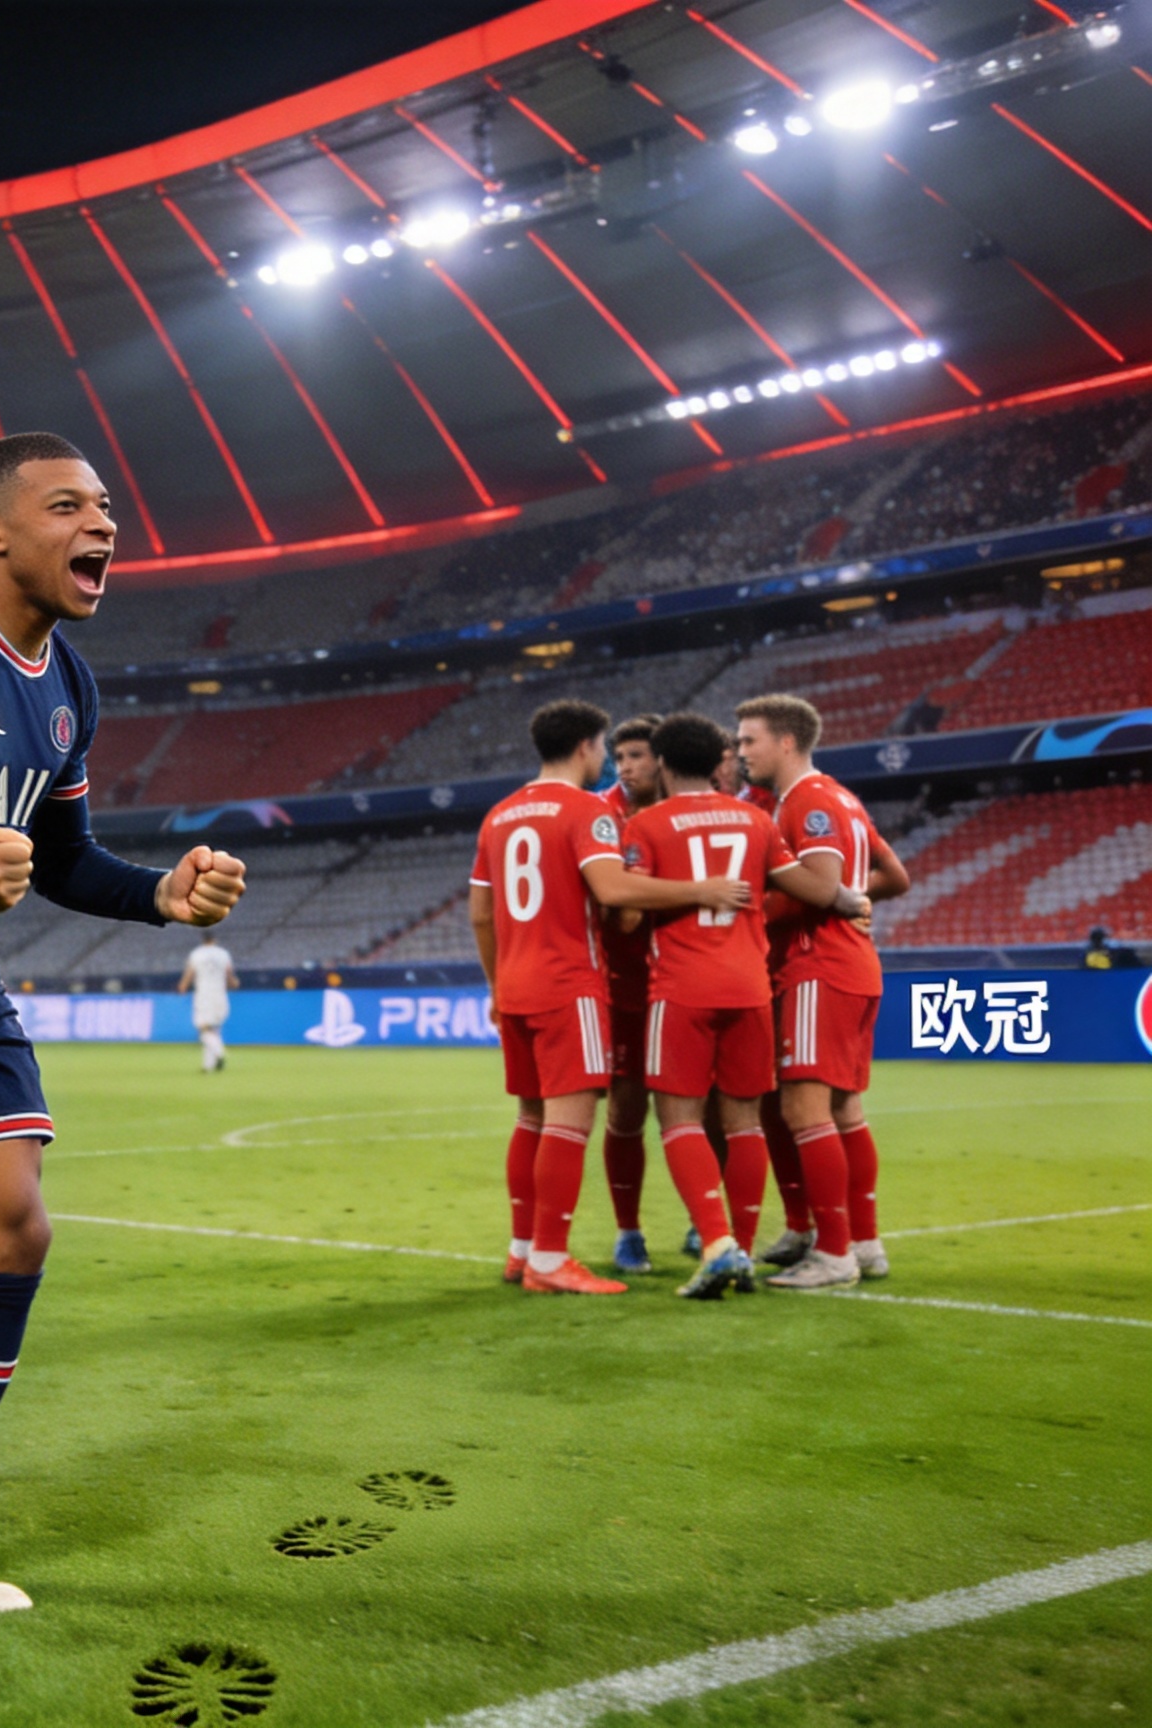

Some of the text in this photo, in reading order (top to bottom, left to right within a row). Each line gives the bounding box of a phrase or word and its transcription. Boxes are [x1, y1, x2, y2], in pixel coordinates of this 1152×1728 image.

[504, 825, 545, 923] 8
[687, 832, 748, 927] 17
[910, 977, 1051, 1055] 欧冠
